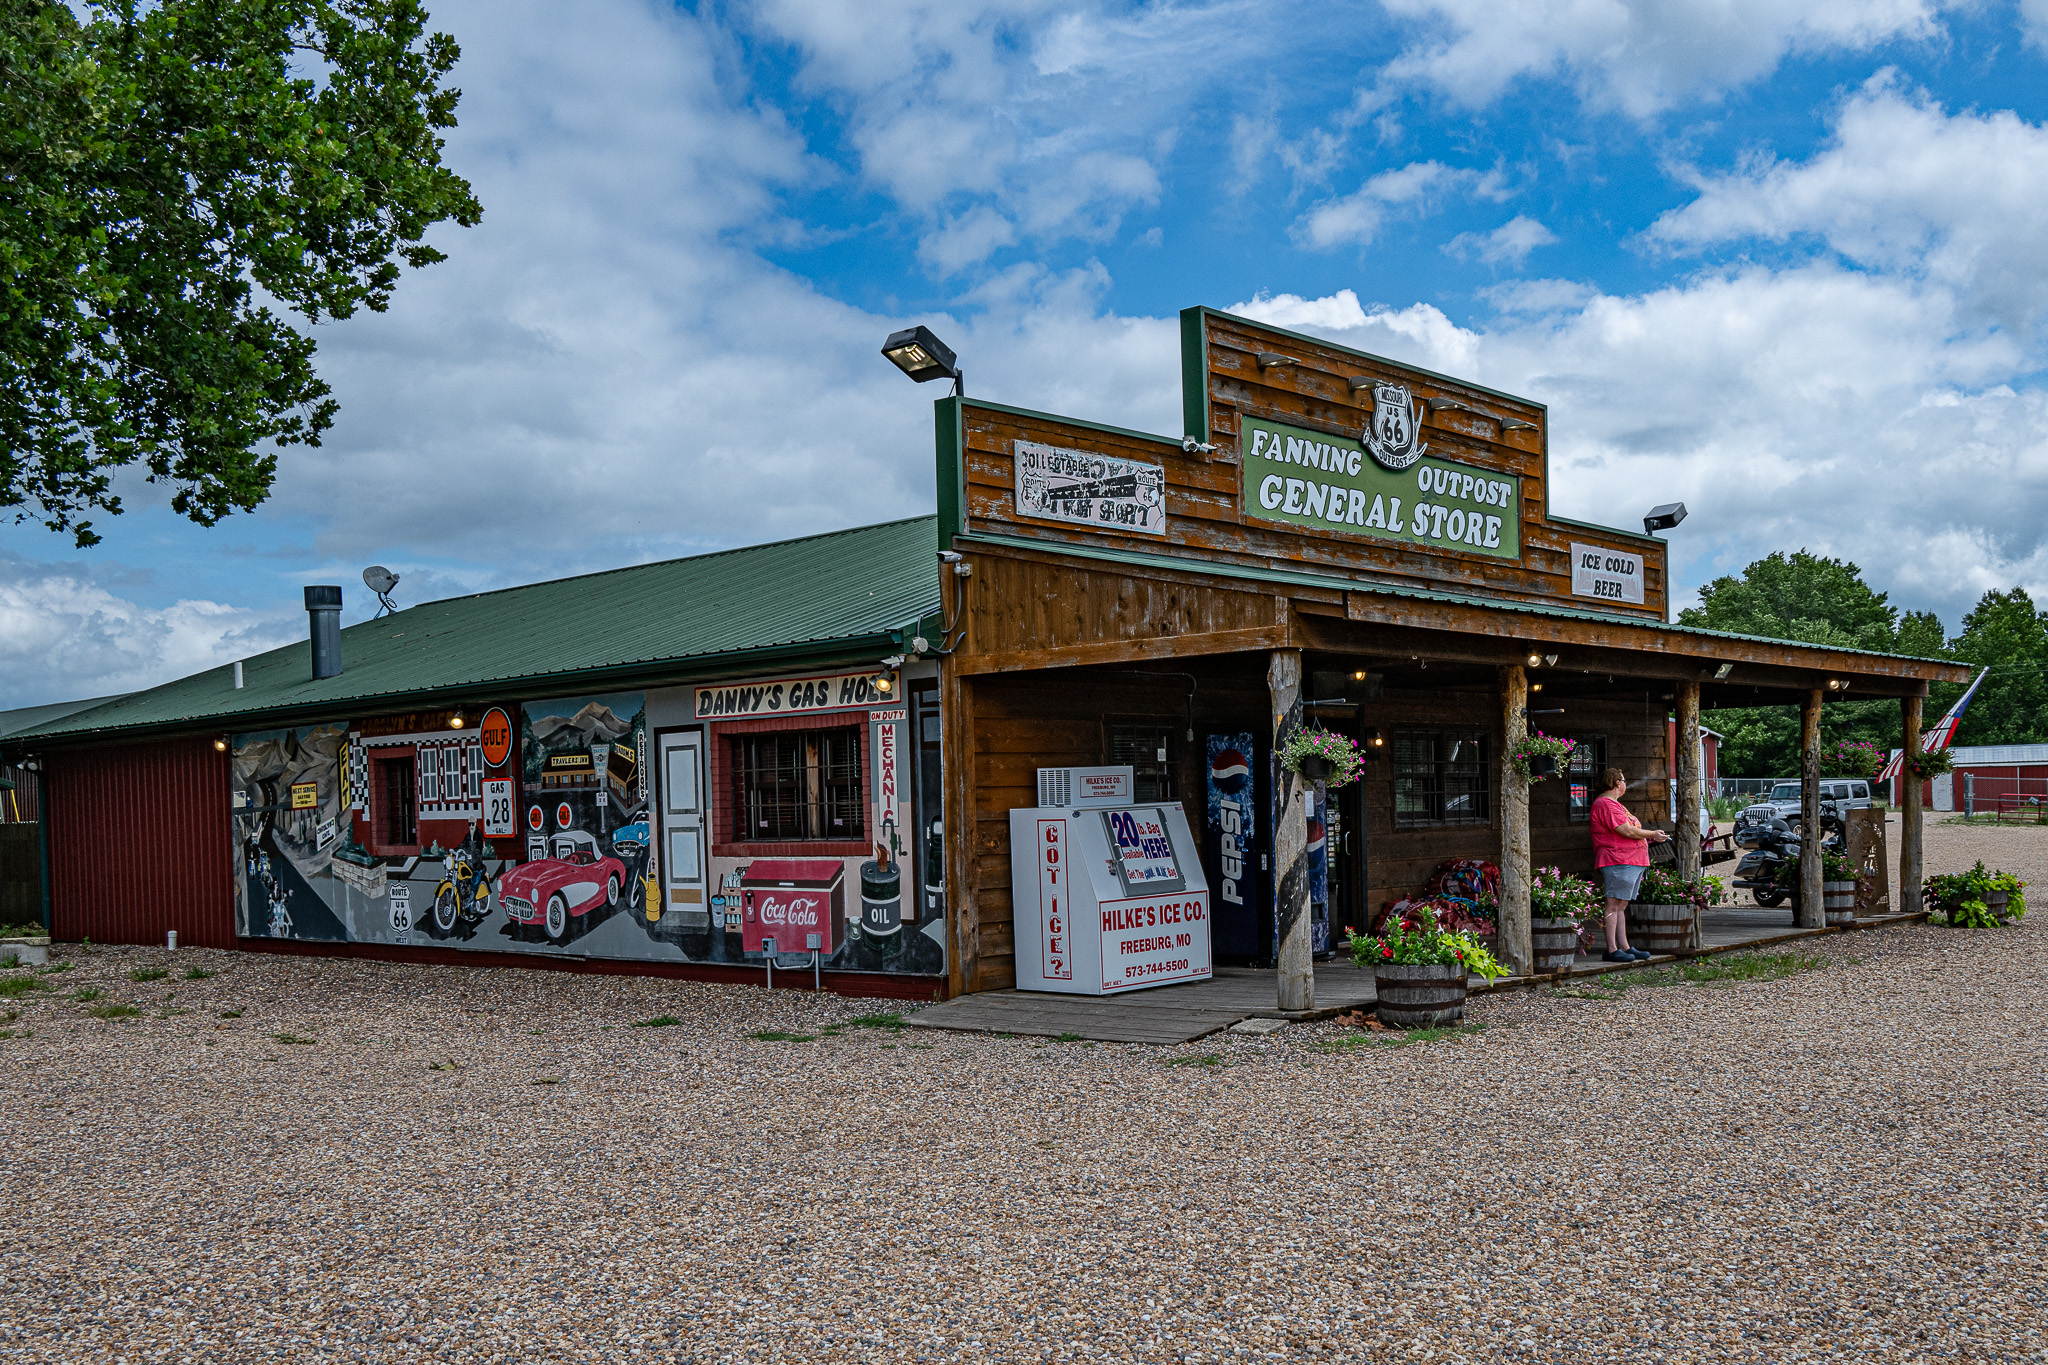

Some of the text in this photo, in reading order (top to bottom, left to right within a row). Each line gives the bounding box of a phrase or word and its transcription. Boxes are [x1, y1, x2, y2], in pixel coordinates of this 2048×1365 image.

[1381, 387, 1403, 404] MISSOURI
[1386, 406, 1400, 418] US
[1383, 417, 1404, 443] 66
[1250, 428, 1512, 508] FANNING OUTPOST
[1379, 448, 1408, 467] OUTPOST
[1137, 475, 1156, 486] ROUTE
[1258, 473, 1502, 549] GENERAL STORE
[1581, 553, 1634, 576] ICE COLD
[1593, 579, 1622, 599] BEER
[698, 684, 784, 716] DANNY'S
[789, 680, 830, 708] GAS
[361, 713, 417, 735] CAROLYN'S
[871, 709, 905, 721] ON DUTY
[483, 728, 508, 747] GULF
[340, 743, 350, 810] EAT
[881, 723, 896, 823] MECHANIC
[1085, 776, 1122, 785] HILKE'S ICE CO.
[293, 785, 316, 795] NEXT SERVICE
[490, 783, 505, 793] GAS
[1804, 750, 1813, 850] OUTPOST
[1110, 811, 1162, 848] 20 lb. Bag
[1045, 824, 1061, 885] GOT
[1121, 836, 1172, 860] vailable HERE
[1220, 800, 1244, 906] PEPSI
[1126, 869, 1136, 880] Get
[1135, 868, 1145, 880] The
[1167, 867, 1178, 879] Bag
[391, 888, 408, 896] ROUTE
[393, 909, 408, 928] 66
[760, 896, 820, 926] Coca Cola
[871, 907, 890, 924] OIL
[1102, 900, 1206, 932] HILKE'S ICE CO.
[1049, 893, 1064, 975] ICE?
[1120, 932, 1192, 955] FREEBURG, MO
[1125, 958, 1189, 979] 573-744-5500
